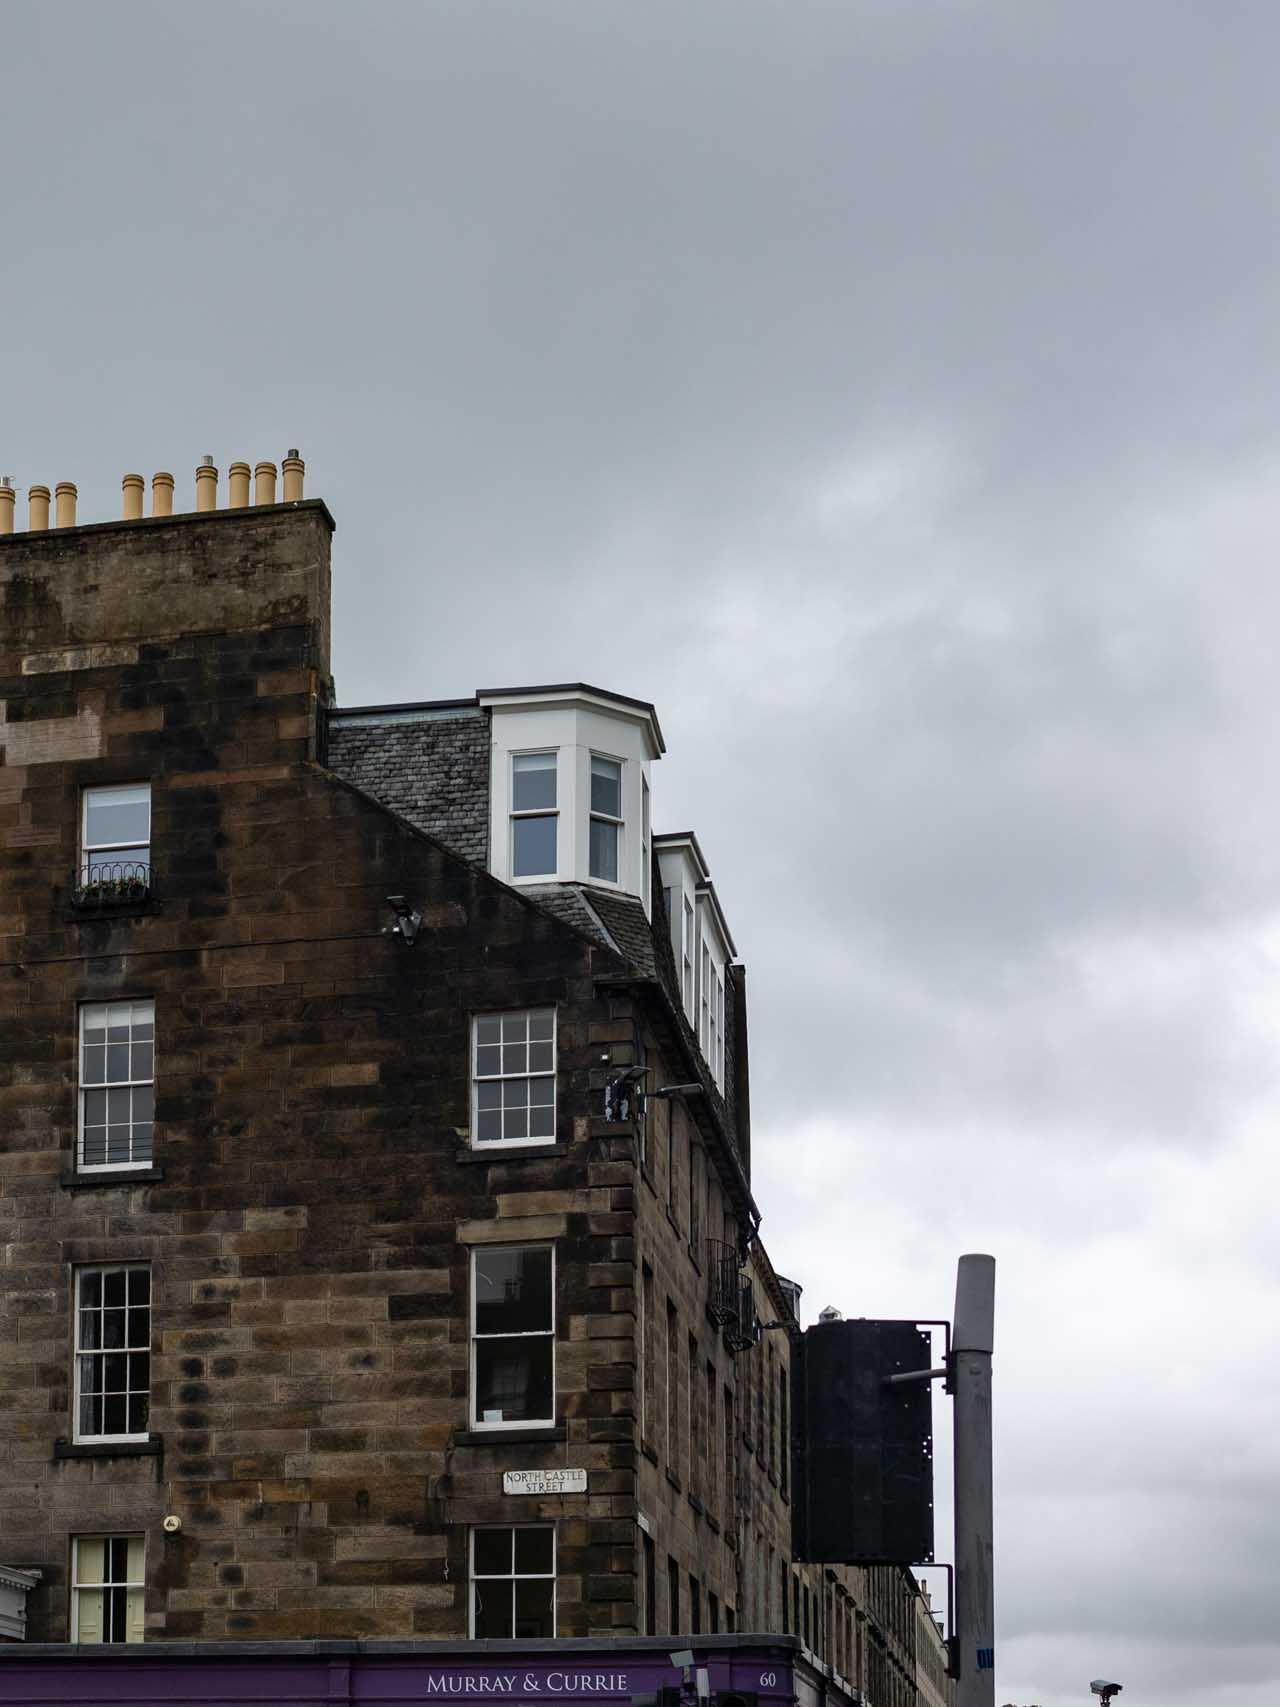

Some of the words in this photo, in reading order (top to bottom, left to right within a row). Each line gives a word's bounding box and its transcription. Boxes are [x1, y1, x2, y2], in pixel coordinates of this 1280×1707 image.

[506, 1472, 542, 1483] NORTH
[545, 1471, 585, 1481] CASTLE
[526, 1481, 565, 1492] STREET
[426, 1674, 517, 1693] MURRAY
[523, 1673, 541, 1691] &
[546, 1673, 628, 1691] CURRIE
[760, 1672, 776, 1688] 60
